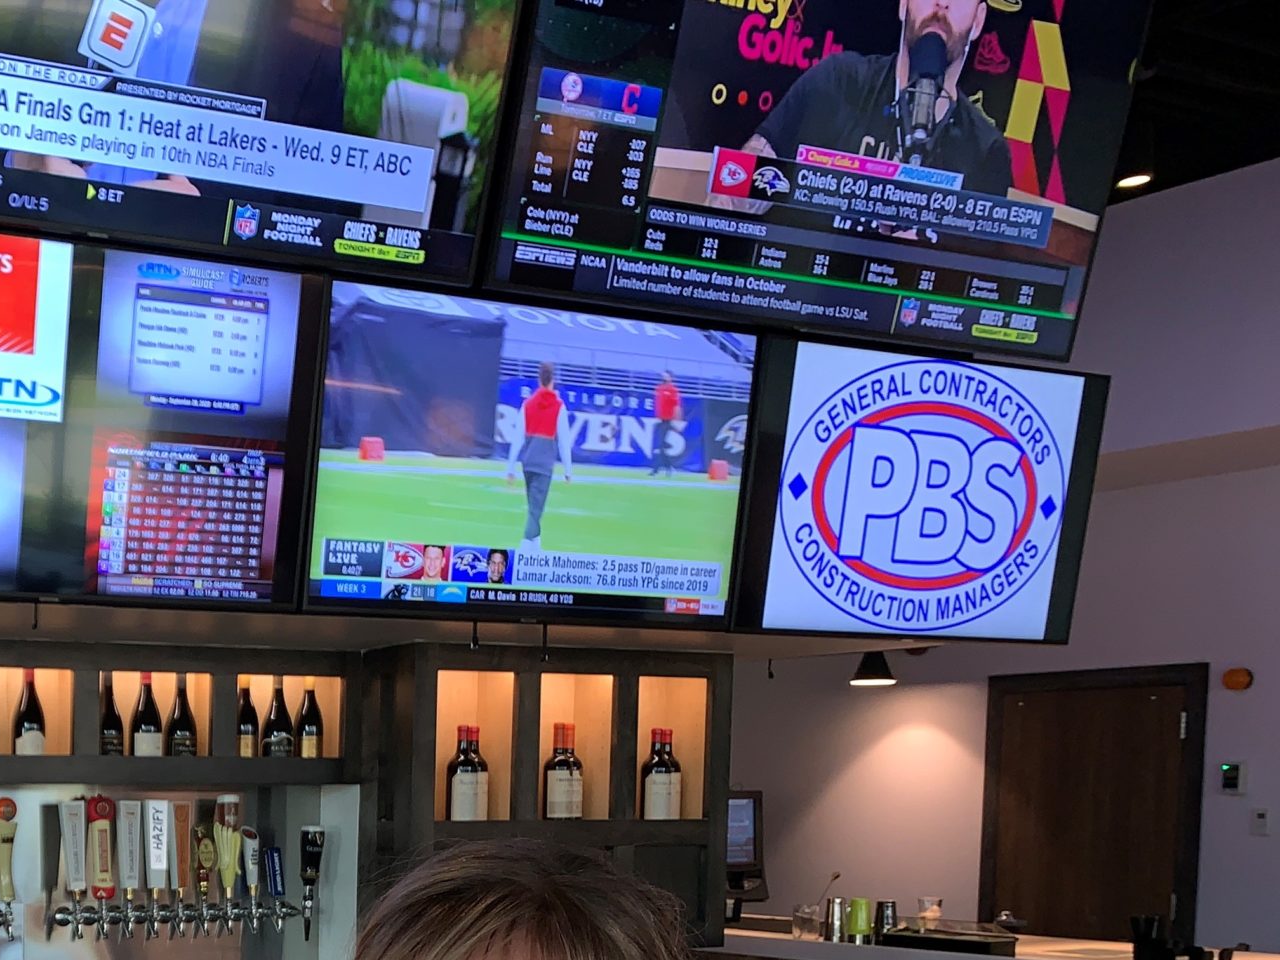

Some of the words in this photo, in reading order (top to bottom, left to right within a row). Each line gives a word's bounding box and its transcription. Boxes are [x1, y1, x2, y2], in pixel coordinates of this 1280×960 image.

[738, 13, 815, 69] Golic
[24, 65, 52, 79] THE
[58, 70, 99, 86] ROAD
[15, 90, 72, 122] Finals
[79, 100, 111, 128] Gm
[119, 106, 133, 131] 1:
[138, 109, 181, 139] Heat
[186, 116, 202, 142] at
[207, 119, 267, 153] Lakers
[284, 133, 324, 162] Wed.
[331, 142, 342, 165] 9
[346, 144, 368, 171] ET,
[374, 149, 412, 176] ABC
[25, 123, 76, 146] James
[80, 132, 135, 159] playing
[141, 142, 155, 158] in
[162, 145, 191, 164] 10th
[195, 151, 228, 170] NBA
[232, 156, 275, 177] Finals
[797, 170, 837, 192] Chiefs
[840, 177, 868, 198] (2-0)
[870, 182, 883, 199] at
[886, 185, 928, 206] Ravens
[931, 193, 957, 213] (2-0)
[965, 199, 974, 214] 8
[976, 201, 992, 217] ET
[993, 207, 1007, 219] on
[1009, 206, 1042, 225] ESPN
[271, 212, 322, 228] MONDAY
[276, 222, 314, 235] NIGHT
[650, 208, 675, 223] ODDS
[676, 212, 688, 225] TO
[688, 214, 706, 228] WIN
[707, 217, 737, 232] WORLD
[738, 222, 767, 236] SERIES
[264, 230, 323, 247] FOOTBALL
[344, 220, 377, 243] CHIEFS
[385, 227, 422, 249] RAVENS
[182, 266, 224, 281] SIMULCAST
[580, 255, 607, 268] NCAA
[616, 258, 669, 278] Vanderbilt
[671, 266, 681, 279] to
[683, 268, 710, 283] allow
[711, 272, 734, 286] fans
[735, 276, 745, 287] in
[746, 277, 786, 292] October
[613, 276, 646, 292] Limited
[647, 281, 681, 296] number
[683, 286, 693, 298] of
[693, 287, 730, 303] students
[732, 293, 740, 304] to
[741, 294, 769, 308] attend
[770, 298, 801, 312] football
[801, 305, 824, 315] game
[825, 308, 834, 316] vs
[835, 308, 853, 318] LSU
[854, 310, 869, 320] Sat.
[814, 372, 912, 444] GENERAL
[919, 369, 1051, 465] CONTRACTORS
[838, 424, 1027, 572] PBS
[329, 540, 381, 555] FANTASY
[329, 552, 358, 565] LIVE
[518, 554, 550, 568] Patrick
[552, 556, 598, 571] Mahomes:
[602, 559, 616, 572] 2.5
[618, 563, 638, 575] pass
[640, 562, 679, 577] TD/game
[680, 564, 688, 576] in
[690, 567, 717, 578] career
[795, 522, 929, 623] CONSTRUCTION
[936, 538, 1039, 621] MANAGERS
[336, 583, 359, 593] WEEK
[361, 583, 367, 593] 3
[516, 570, 548, 584] Lamar
[550, 572, 592, 586] Jackson:
[596, 574, 616, 587] 76.8
[618, 575, 638, 588] rush
[641, 576, 659, 589] YPG
[660, 577, 685, 590] since
[686, 578, 708, 592] 2019
[152, 807, 164, 850] HAZIFY
